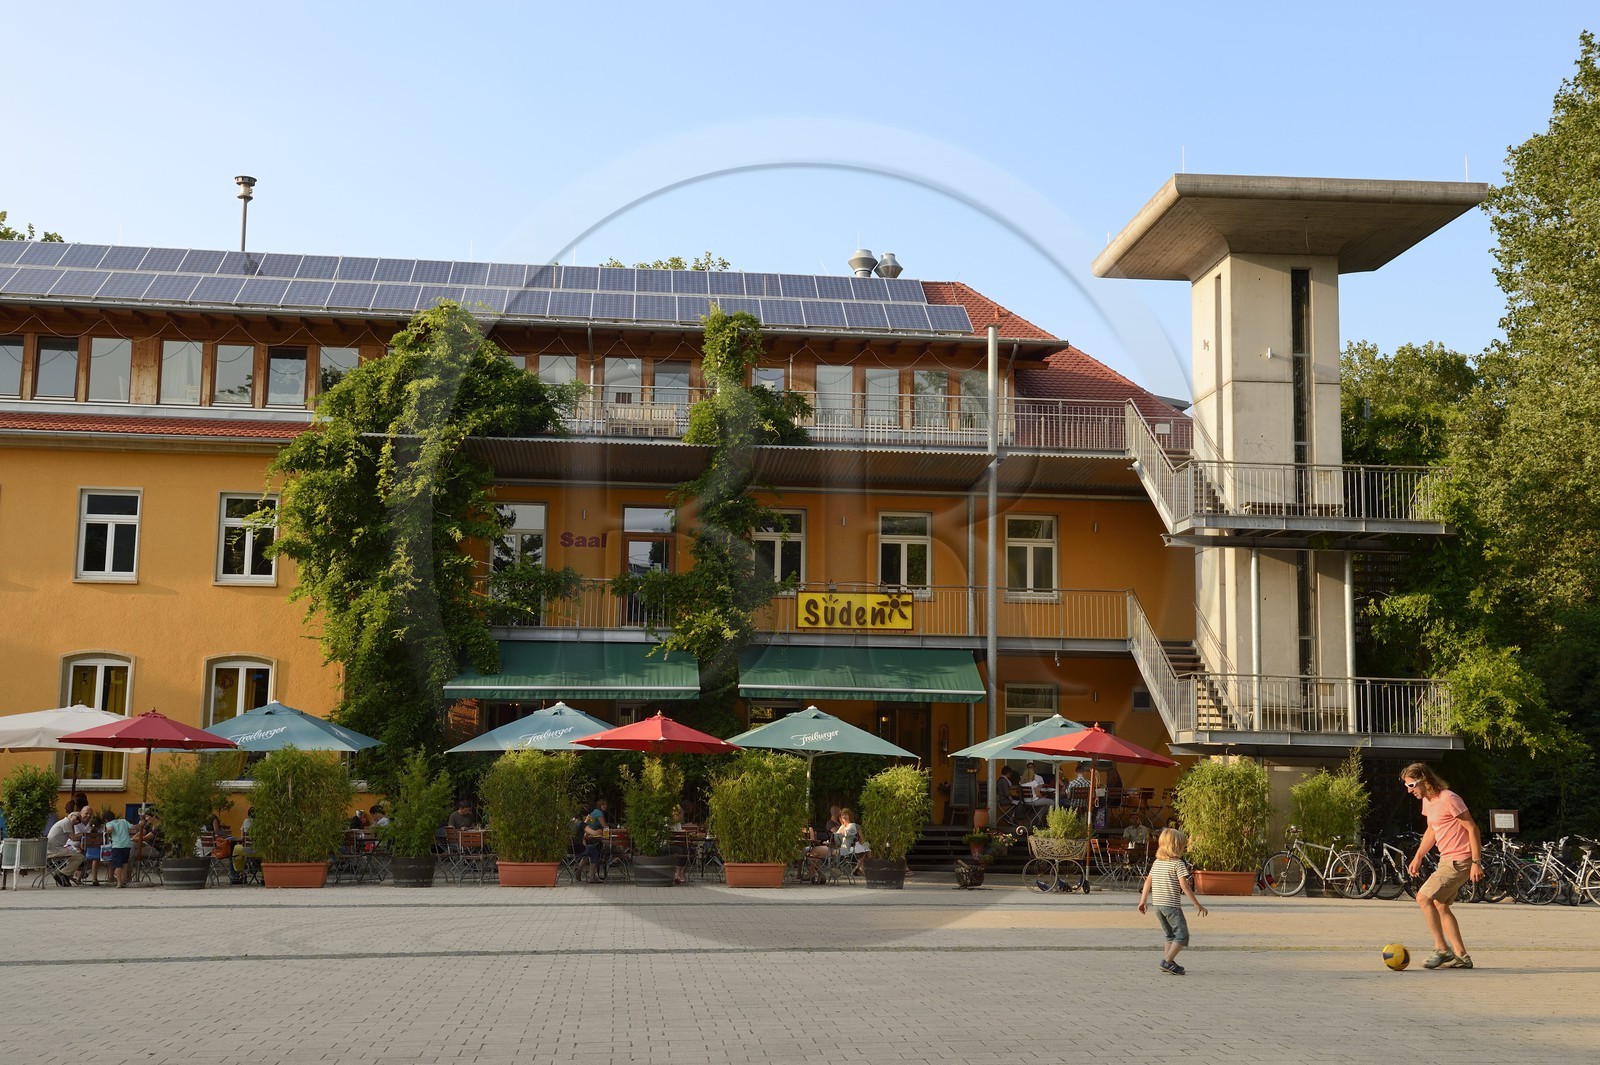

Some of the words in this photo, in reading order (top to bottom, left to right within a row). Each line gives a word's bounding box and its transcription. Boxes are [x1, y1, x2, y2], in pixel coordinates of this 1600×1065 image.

[560, 531, 607, 548] Saal
[803, 594, 886, 626] Süden
[227, 725, 287, 745] Freiburger
[518, 726, 574, 746] Freiburger
[790, 729, 839, 747] Freiburger
